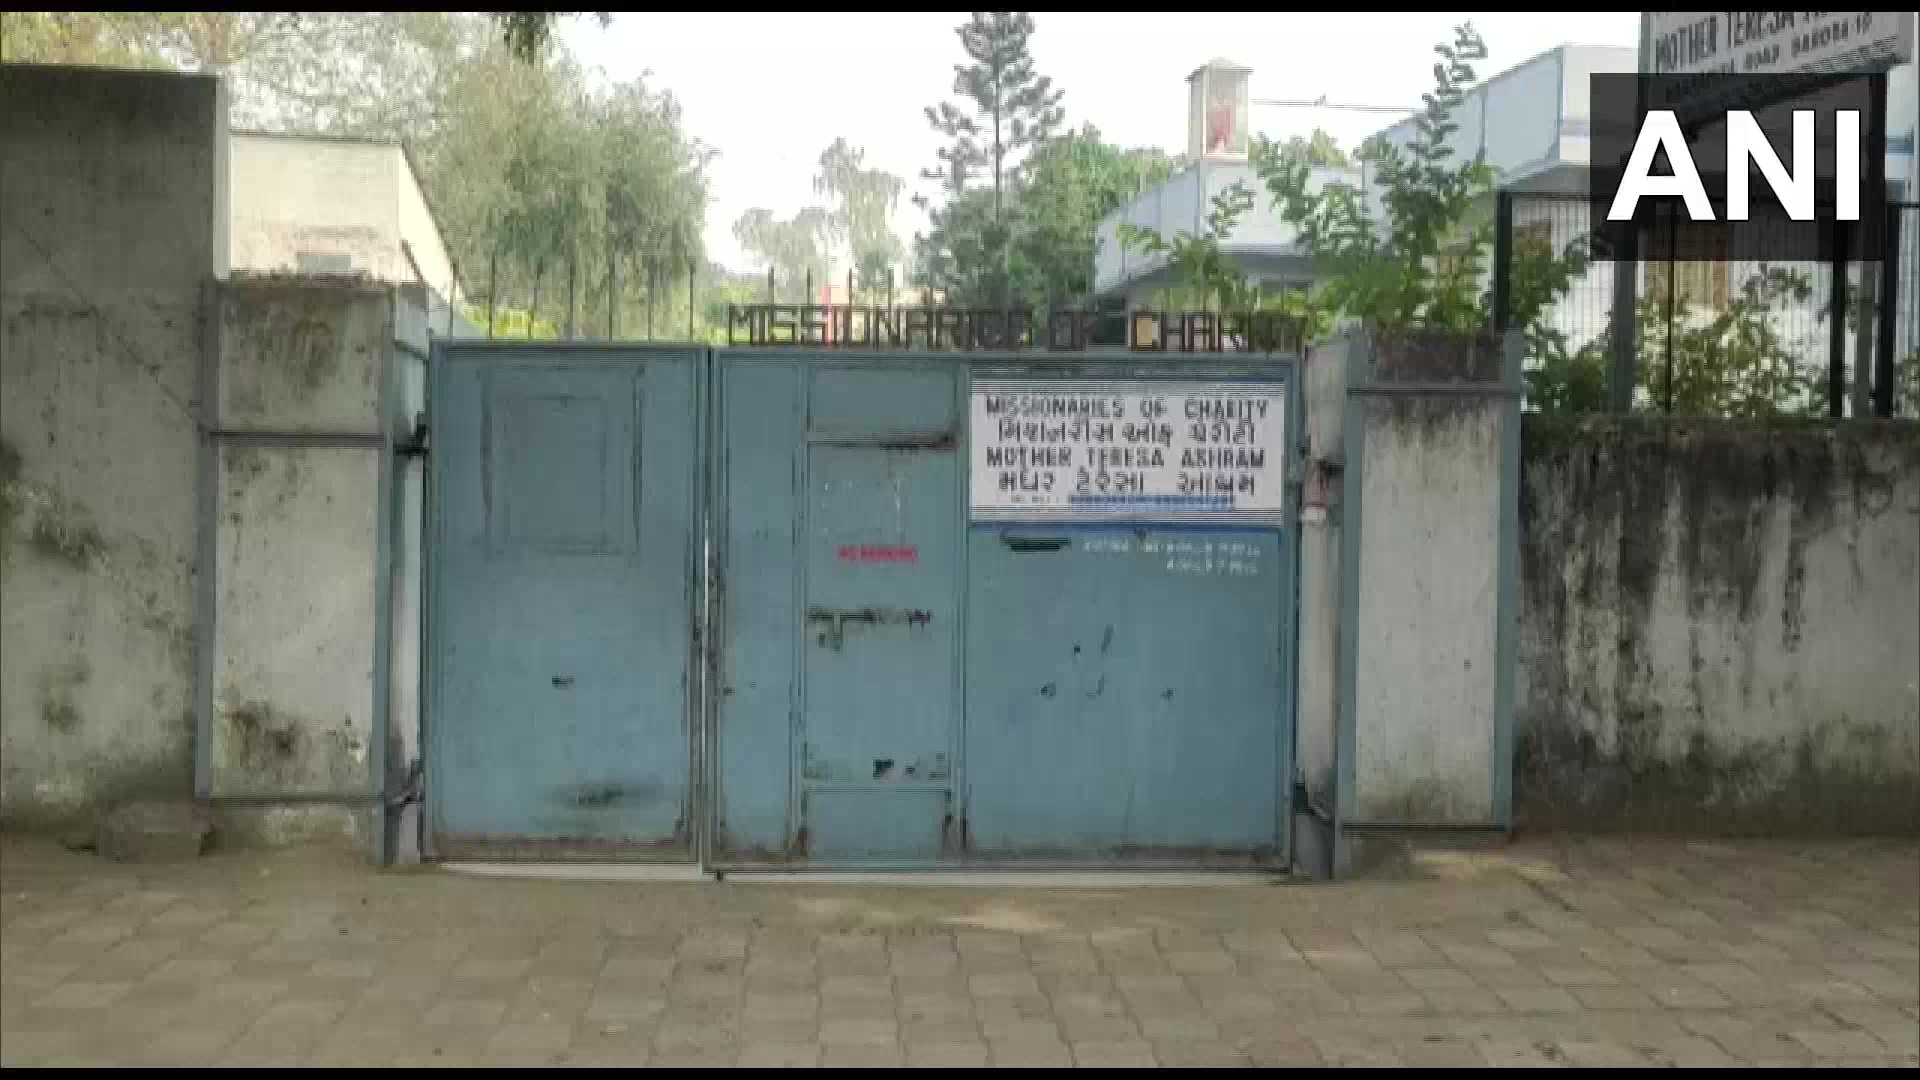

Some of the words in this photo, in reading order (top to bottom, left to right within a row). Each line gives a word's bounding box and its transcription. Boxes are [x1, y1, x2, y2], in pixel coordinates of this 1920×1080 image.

[986, 394, 1125, 419] MISSIONARIES
[1139, 396, 1168, 420] OF
[1185, 398, 1268, 420] CHARITY
[986, 447, 1073, 468] MOTHER
[1088, 447, 1165, 468] TERESA
[1181, 447, 1265, 468] ASHRAM
